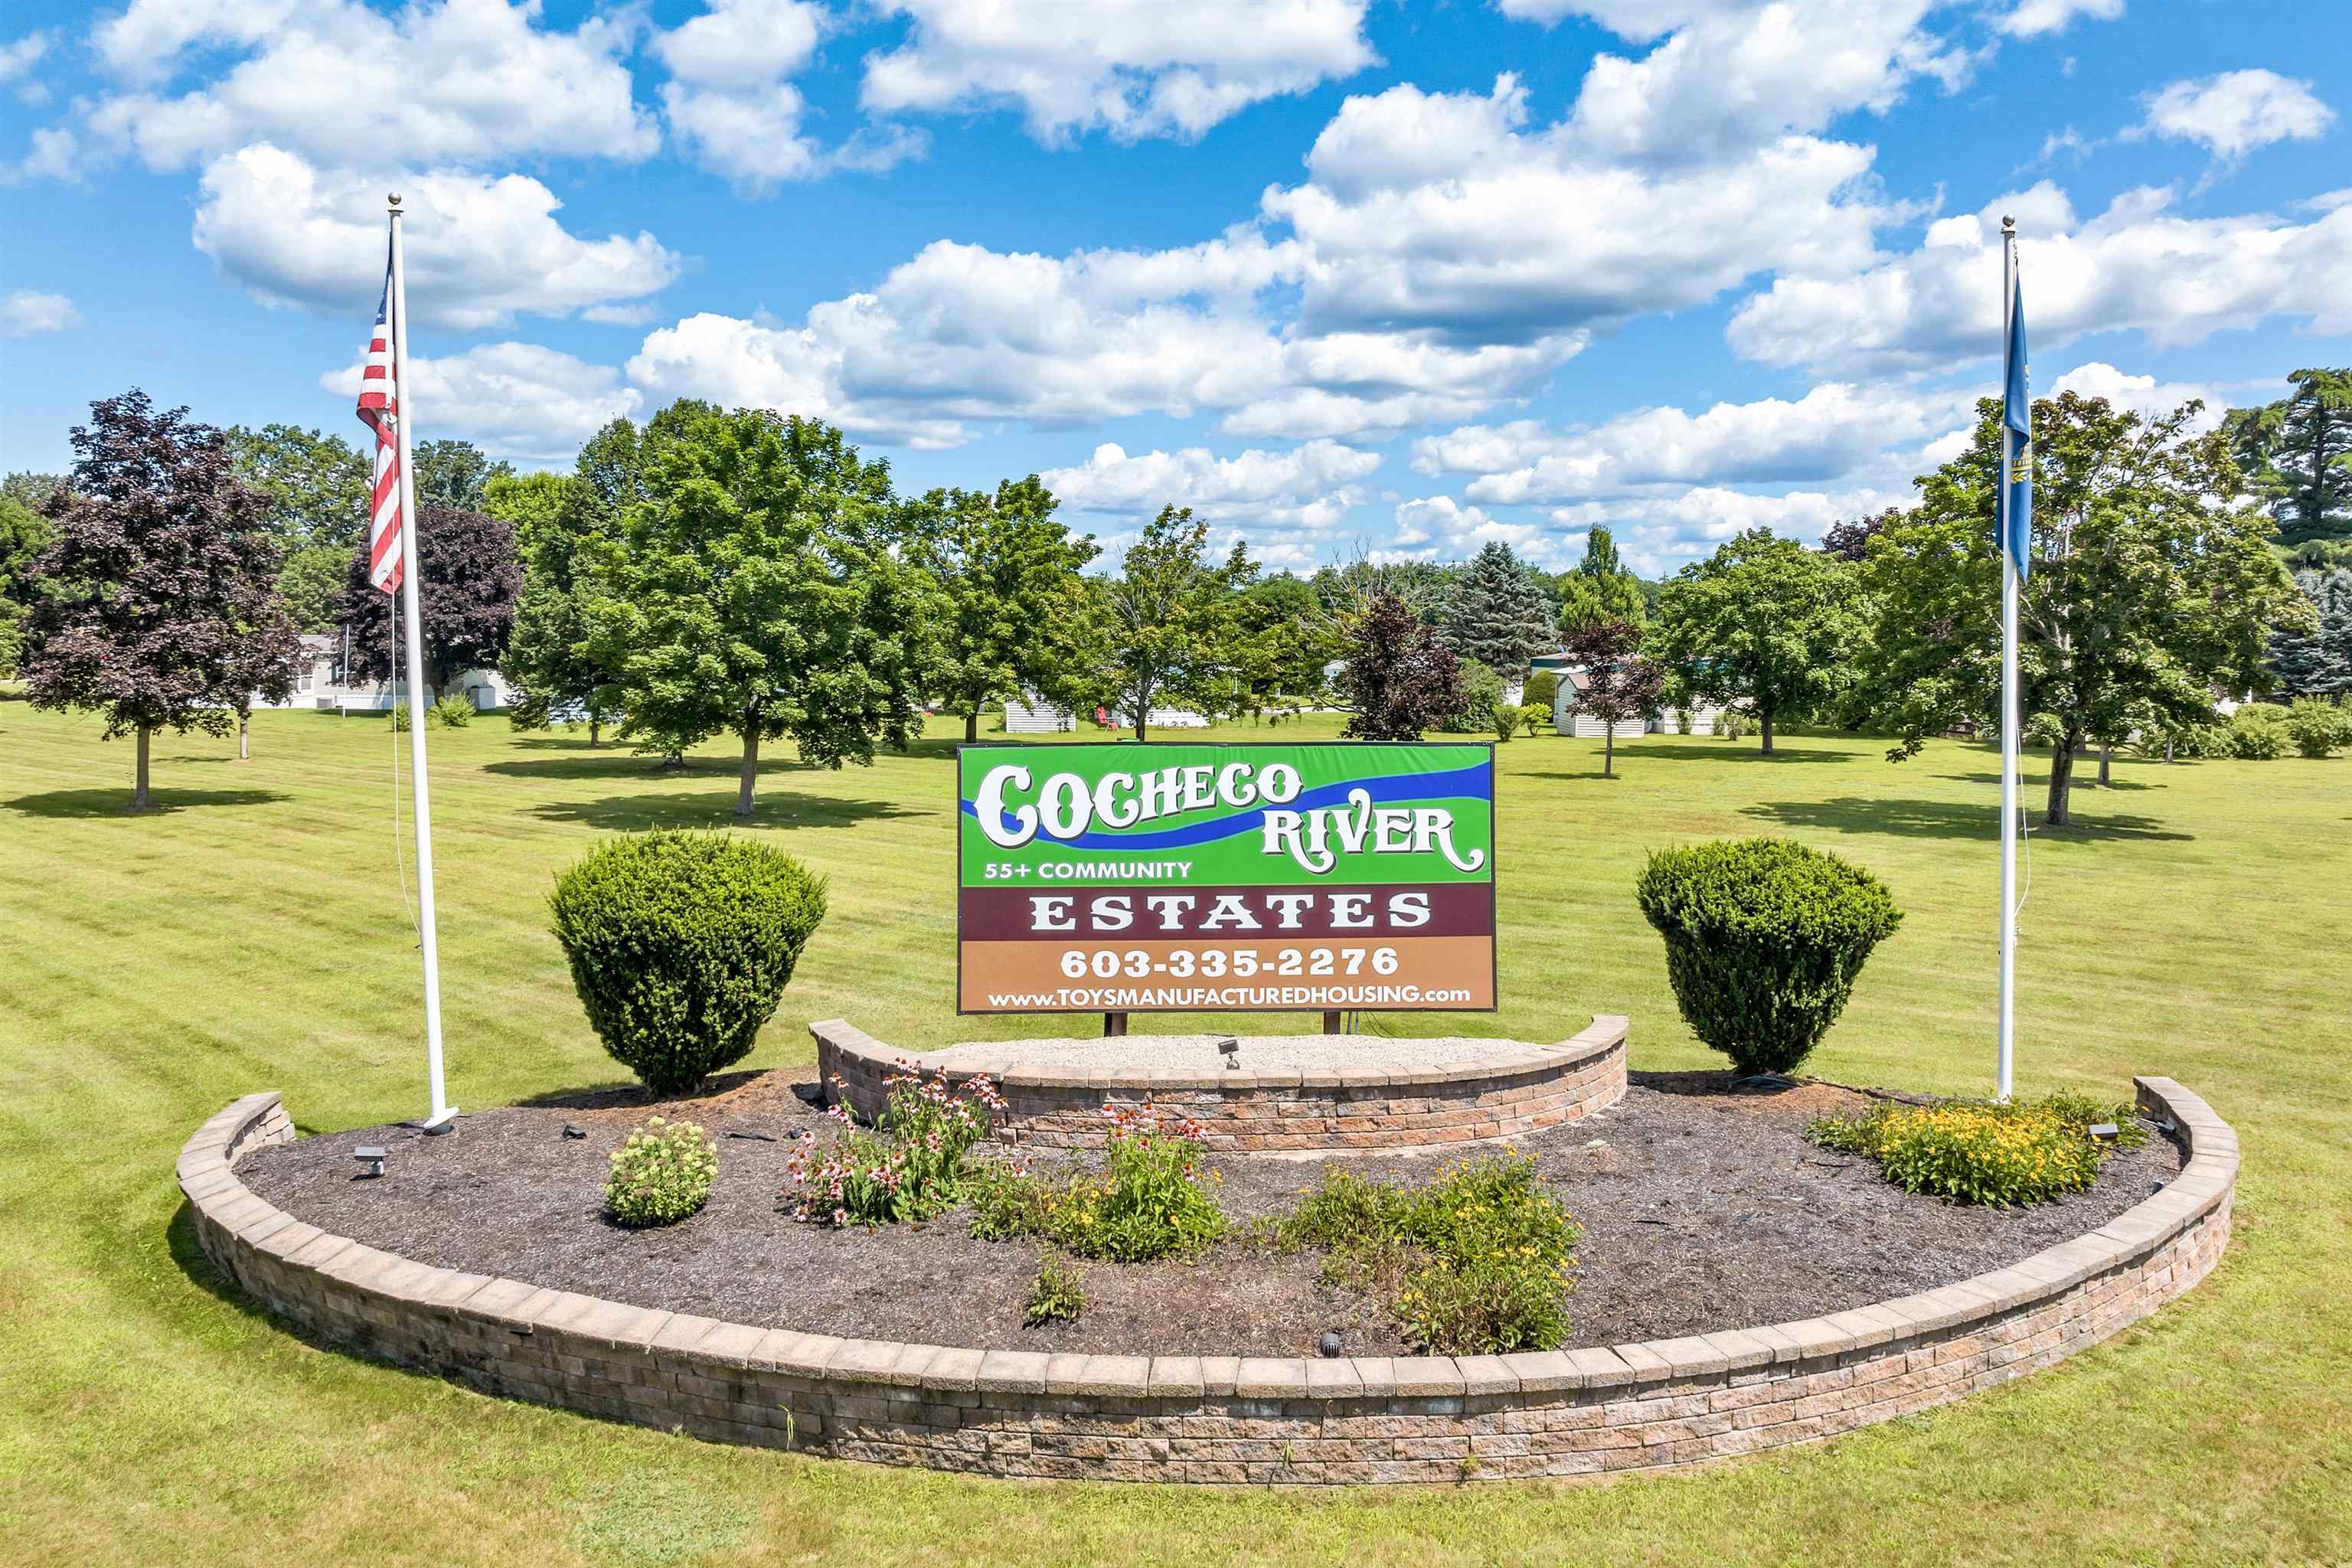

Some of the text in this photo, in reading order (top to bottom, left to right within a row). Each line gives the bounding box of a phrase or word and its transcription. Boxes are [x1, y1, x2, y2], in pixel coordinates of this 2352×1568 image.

[973, 763, 1304, 849] COCHECO
[1262, 788, 1485, 874] RIVER
[985, 862, 1193, 879] 55+ COMMUNITY
[1028, 892, 1431, 930] ESTATES
[1060, 947, 1400, 978] 603-335-2276
[987, 985, 1471, 1006] www.TOYSMANUFACTUREDHOUSING.com
